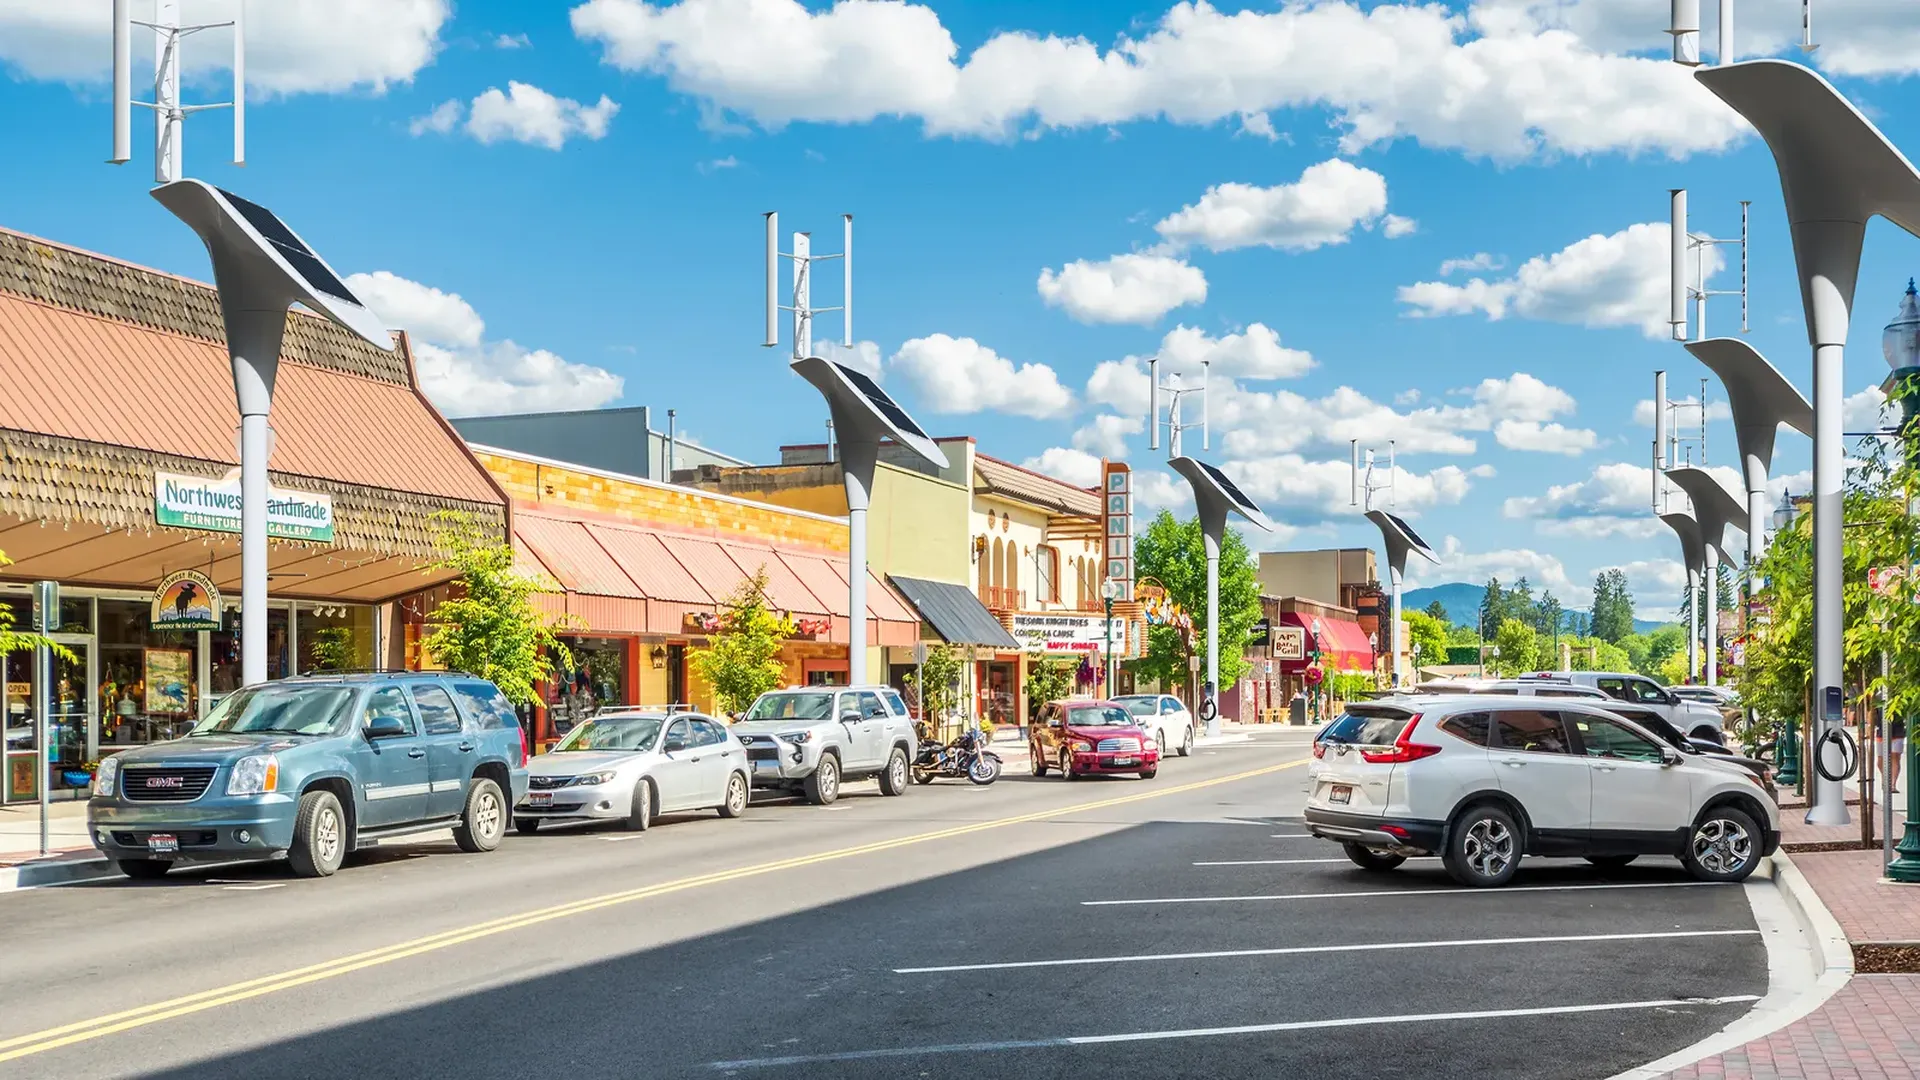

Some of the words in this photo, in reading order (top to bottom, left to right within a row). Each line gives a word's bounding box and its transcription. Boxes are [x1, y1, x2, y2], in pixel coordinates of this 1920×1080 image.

[165, 479, 243, 510] Northwes
[267, 496, 327, 521] andmade
[183, 513, 243, 530] FURNITURE
[268, 524, 313, 537] GALLERY
[1110, 474, 1124, 599] PANIDA
[155, 571, 186, 601] Northwest
[187, 571, 217, 600] Handmade
[1045, 617, 1068, 626] KNIGHT
[1068, 618, 1089, 628] RISES
[1052, 629, 1075, 639] CAUSE
[1046, 641, 1069, 650] HAPPY
[1070, 641, 1099, 651] SUMMER
[1281, 644, 1299, 654] Grill
[7, 684, 28, 693] OPEN
[145, 776, 184, 788] GMC
